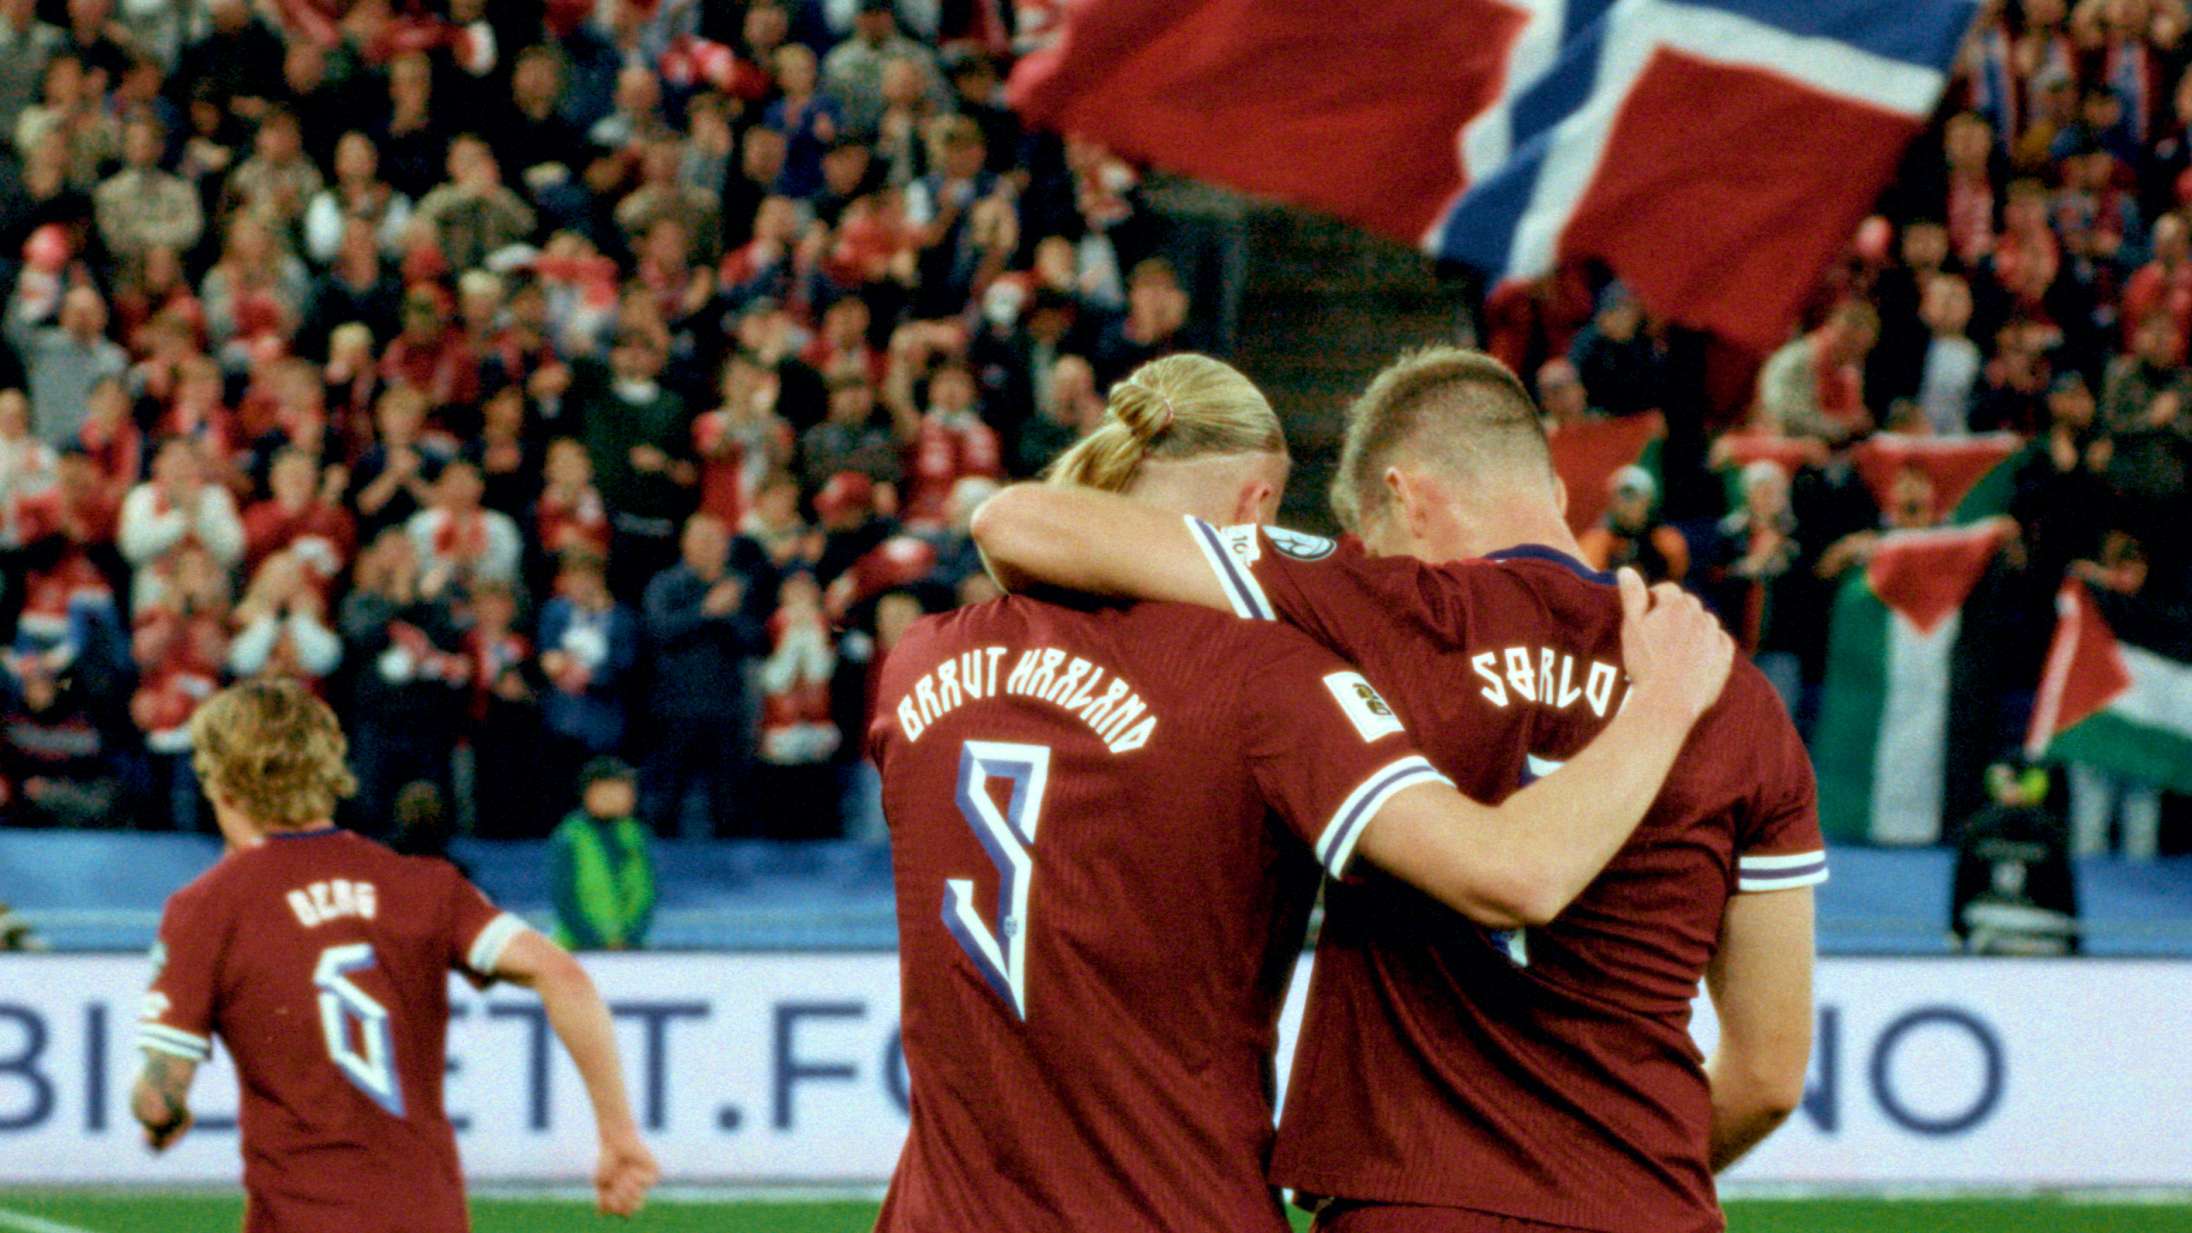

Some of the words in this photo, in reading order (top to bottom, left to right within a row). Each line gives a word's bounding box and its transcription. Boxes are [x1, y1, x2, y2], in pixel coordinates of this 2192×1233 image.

[896, 646, 1008, 743] BRAUT
[1006, 646, 1158, 754] HAALAND
[286, 878, 376, 927] BERG
[939, 738, 1052, 1022] 9
[312, 942, 407, 1118] 6
